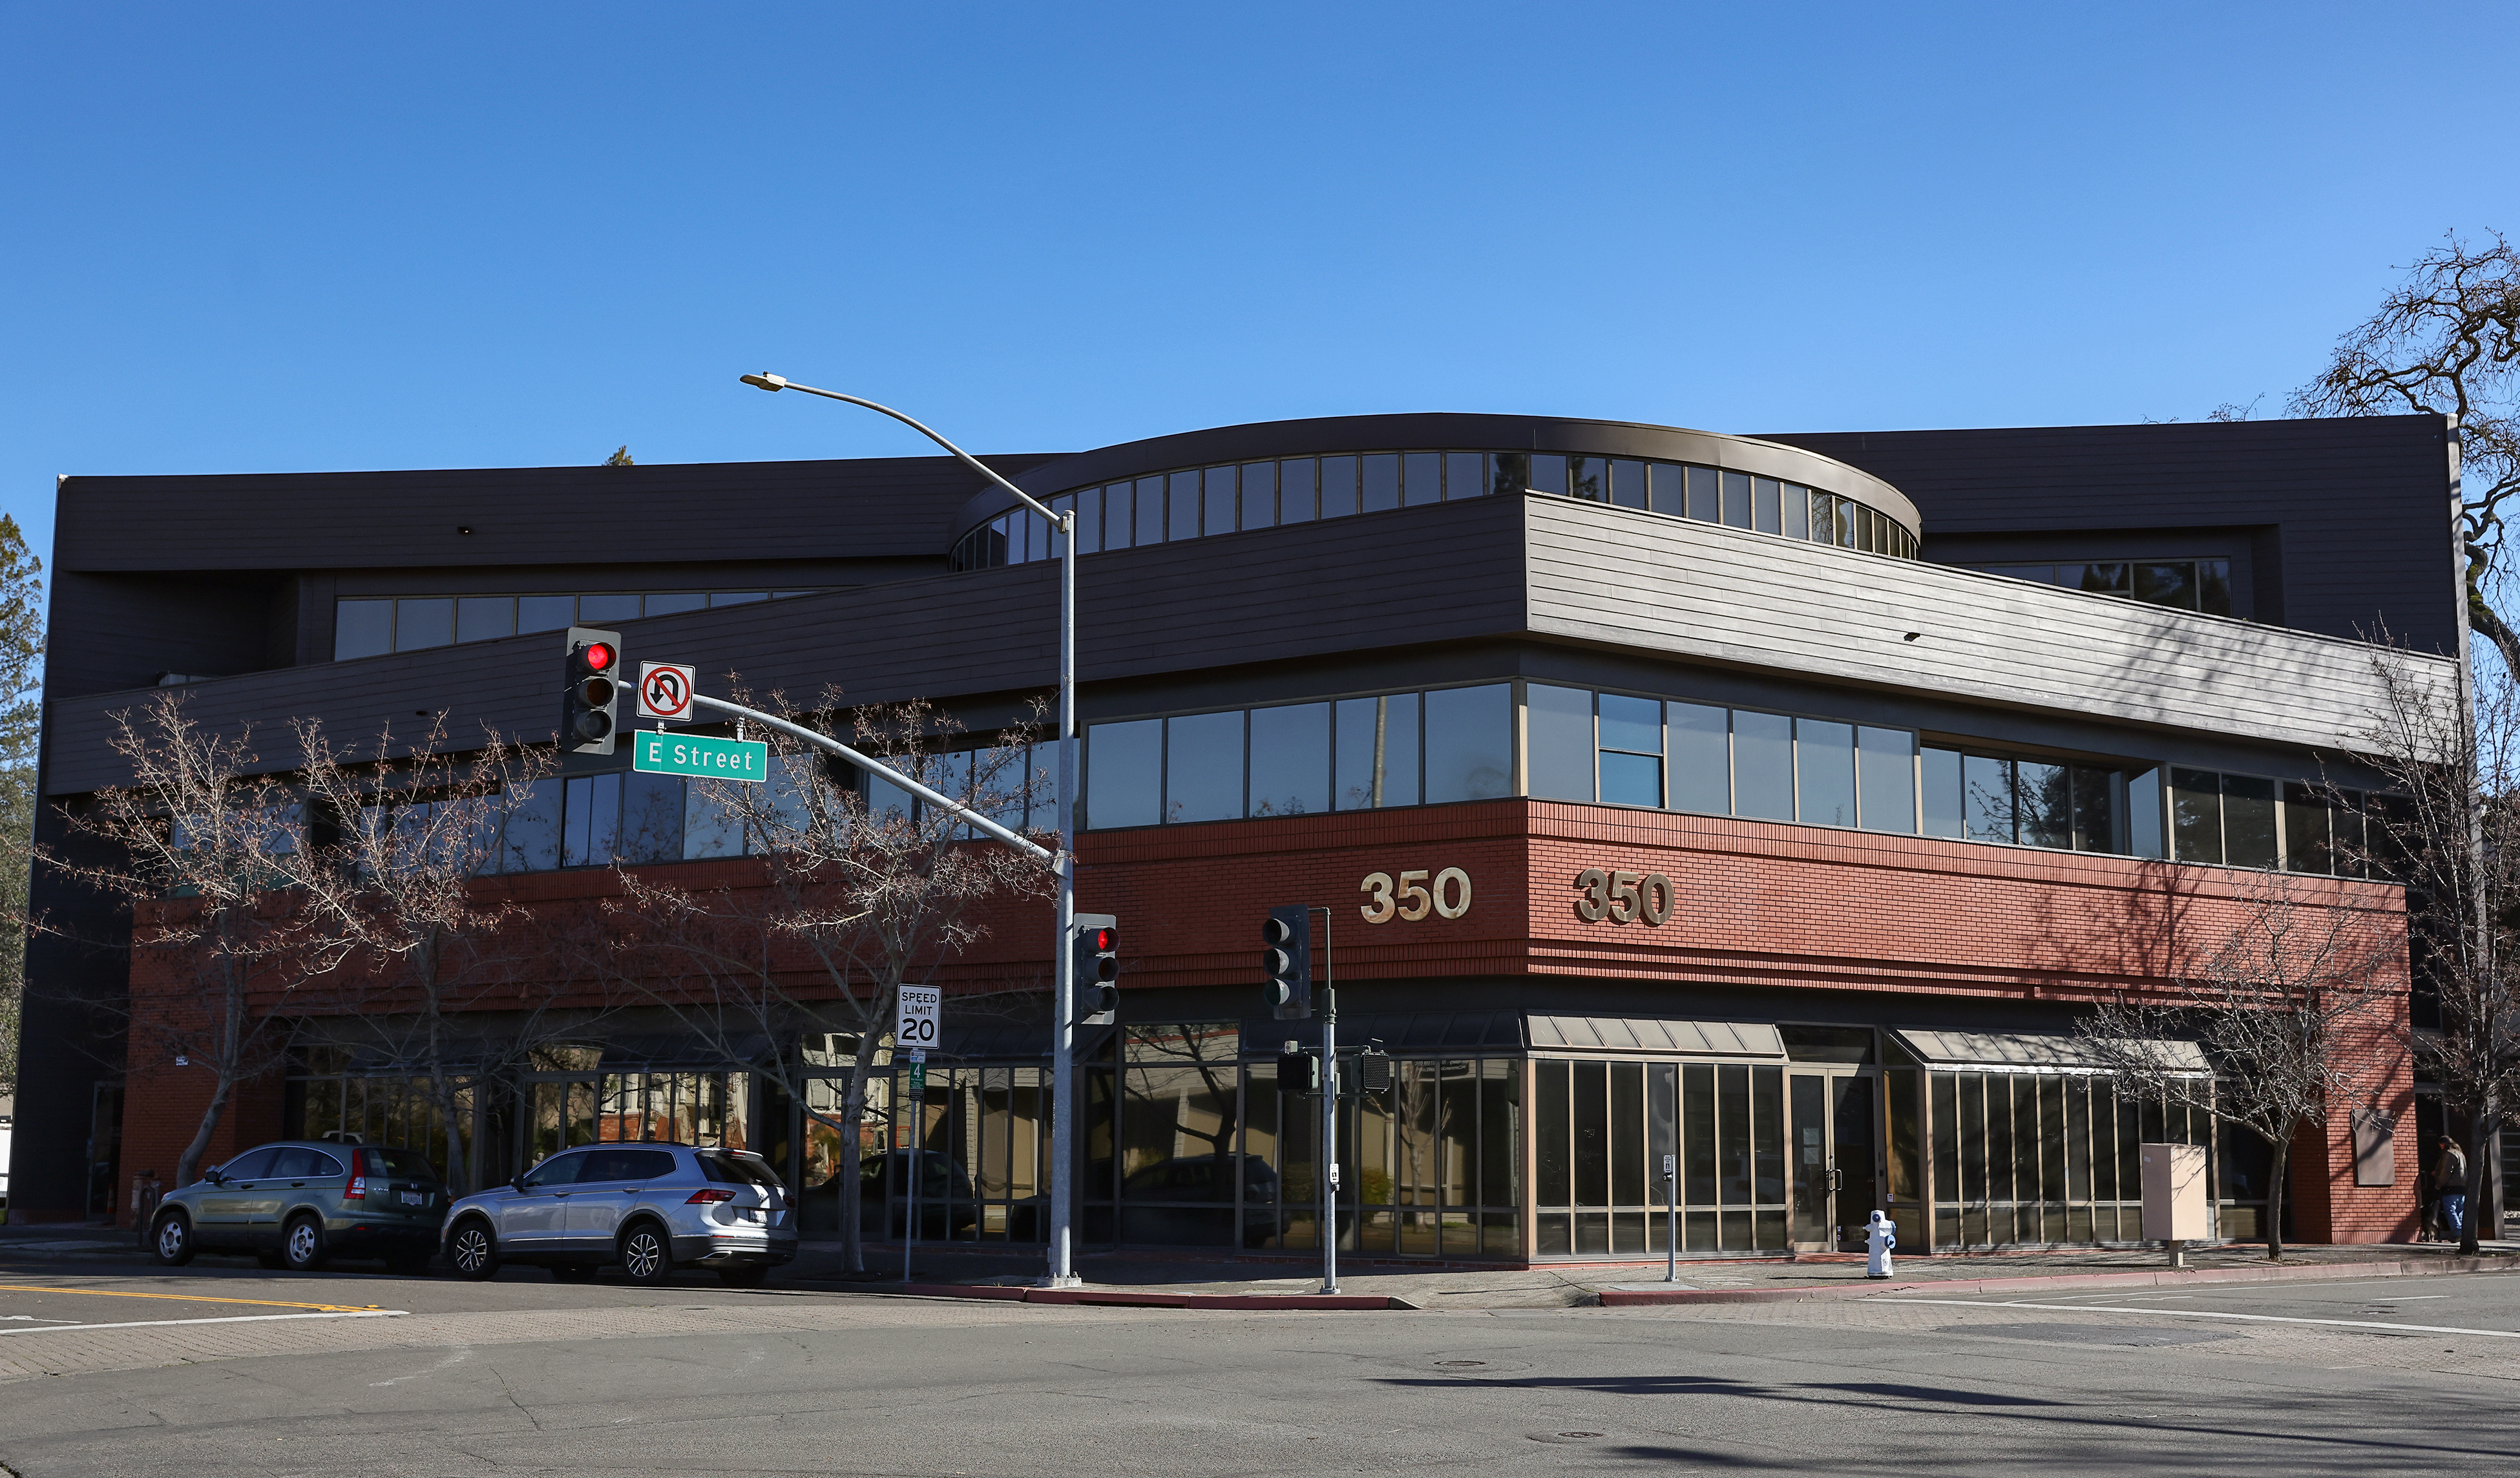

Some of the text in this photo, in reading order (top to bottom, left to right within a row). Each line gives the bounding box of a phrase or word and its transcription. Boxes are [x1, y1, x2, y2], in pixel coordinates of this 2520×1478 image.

[649, 742, 753, 771] E Street
[1360, 866, 1472, 924] 350
[1577, 867, 1675, 925] 350
[901, 991, 937, 1003] SPEED
[905, 1004, 932, 1015] LIMIT
[901, 1017, 935, 1042] 20
[913, 1064, 921, 1079] 4
